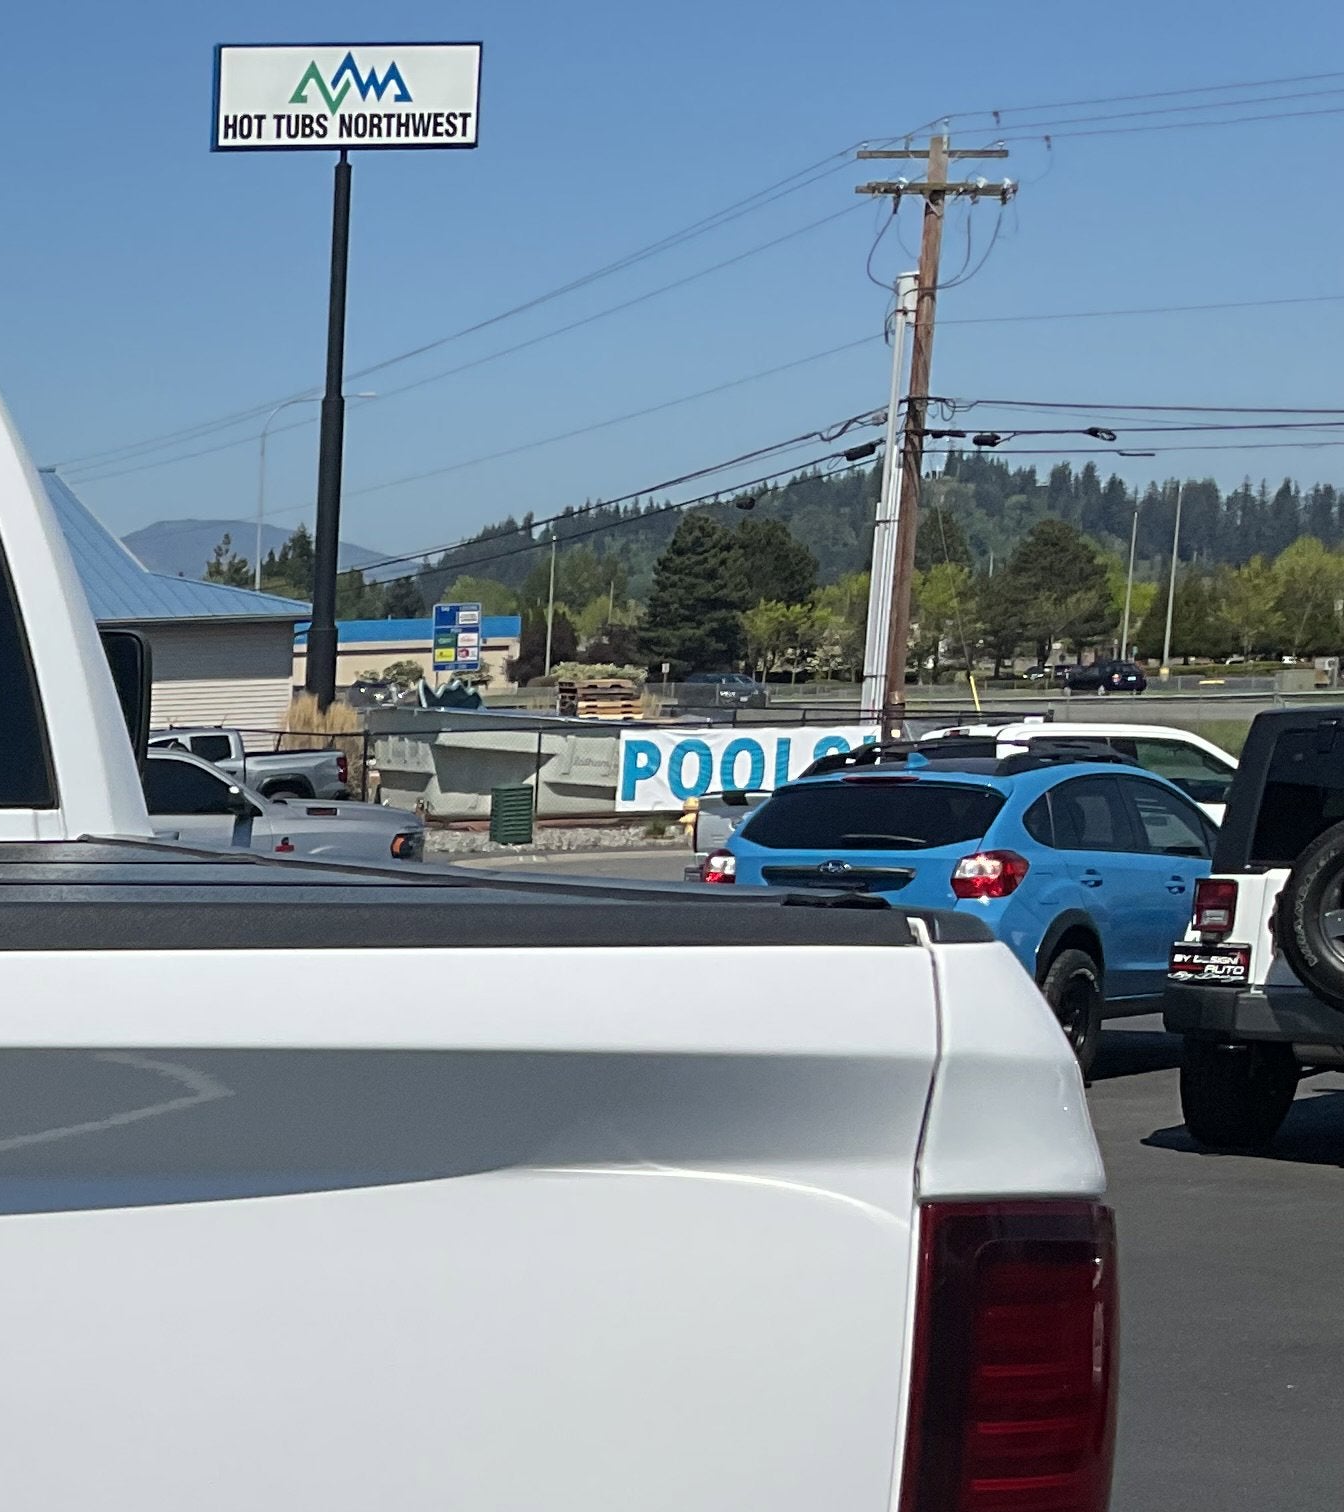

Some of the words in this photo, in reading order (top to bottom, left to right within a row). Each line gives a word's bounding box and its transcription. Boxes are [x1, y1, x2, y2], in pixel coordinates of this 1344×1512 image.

[223, 114, 266, 140] HOT
[273, 114, 328, 139] TUBS
[338, 112, 472, 138] NORTHWEST
[1204, 964, 1245, 975] AUTO
